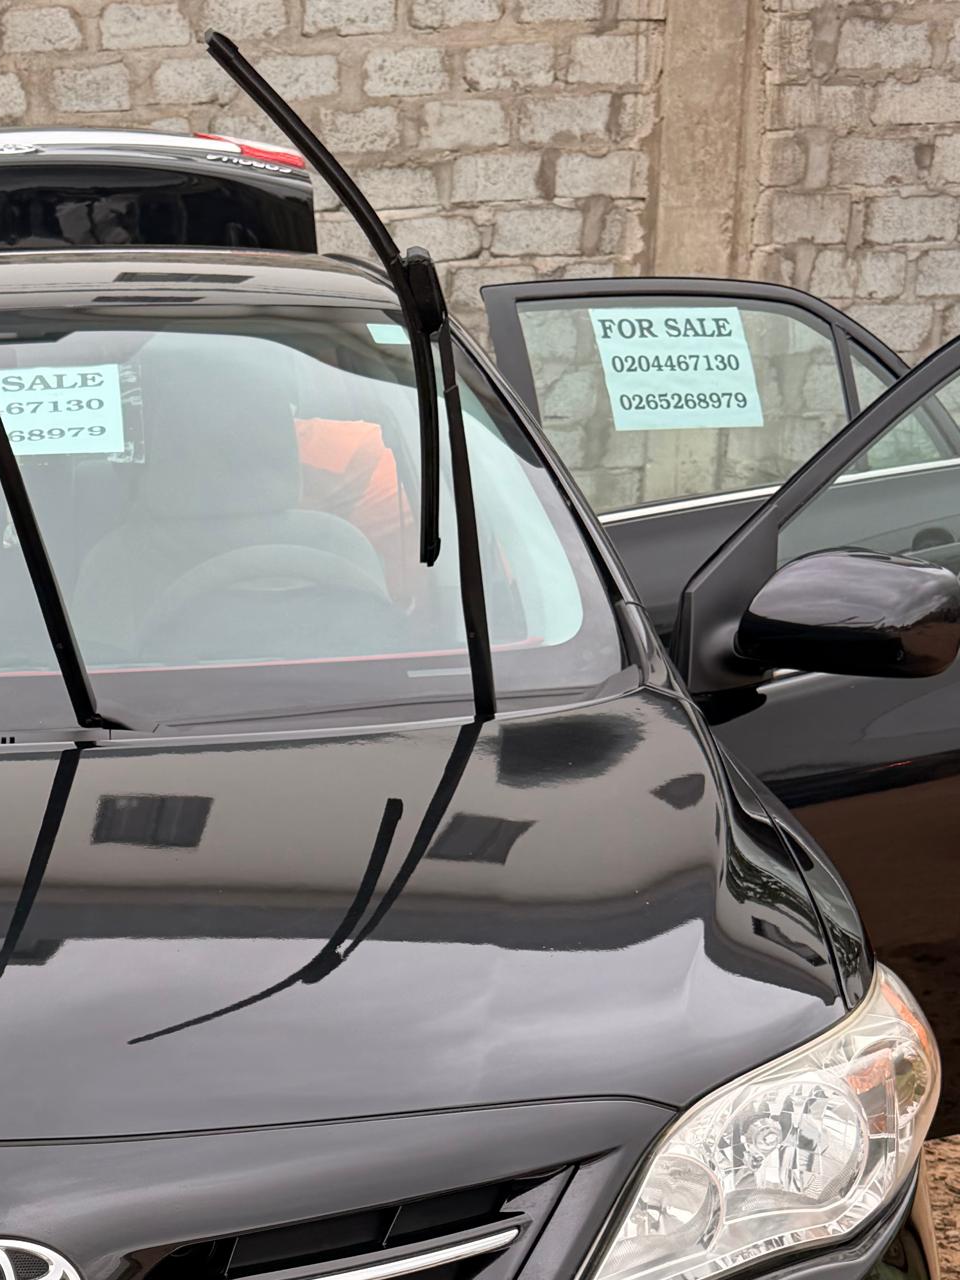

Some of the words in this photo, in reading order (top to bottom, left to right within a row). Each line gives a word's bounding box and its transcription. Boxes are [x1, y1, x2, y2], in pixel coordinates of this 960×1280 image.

[598, 318, 658, 339] FOR
[664, 318, 733, 338] SALE
[611, 354, 740, 373] 0204467130
[1, 372, 104, 393] SALE
[619, 392, 748, 411] 0265268979
